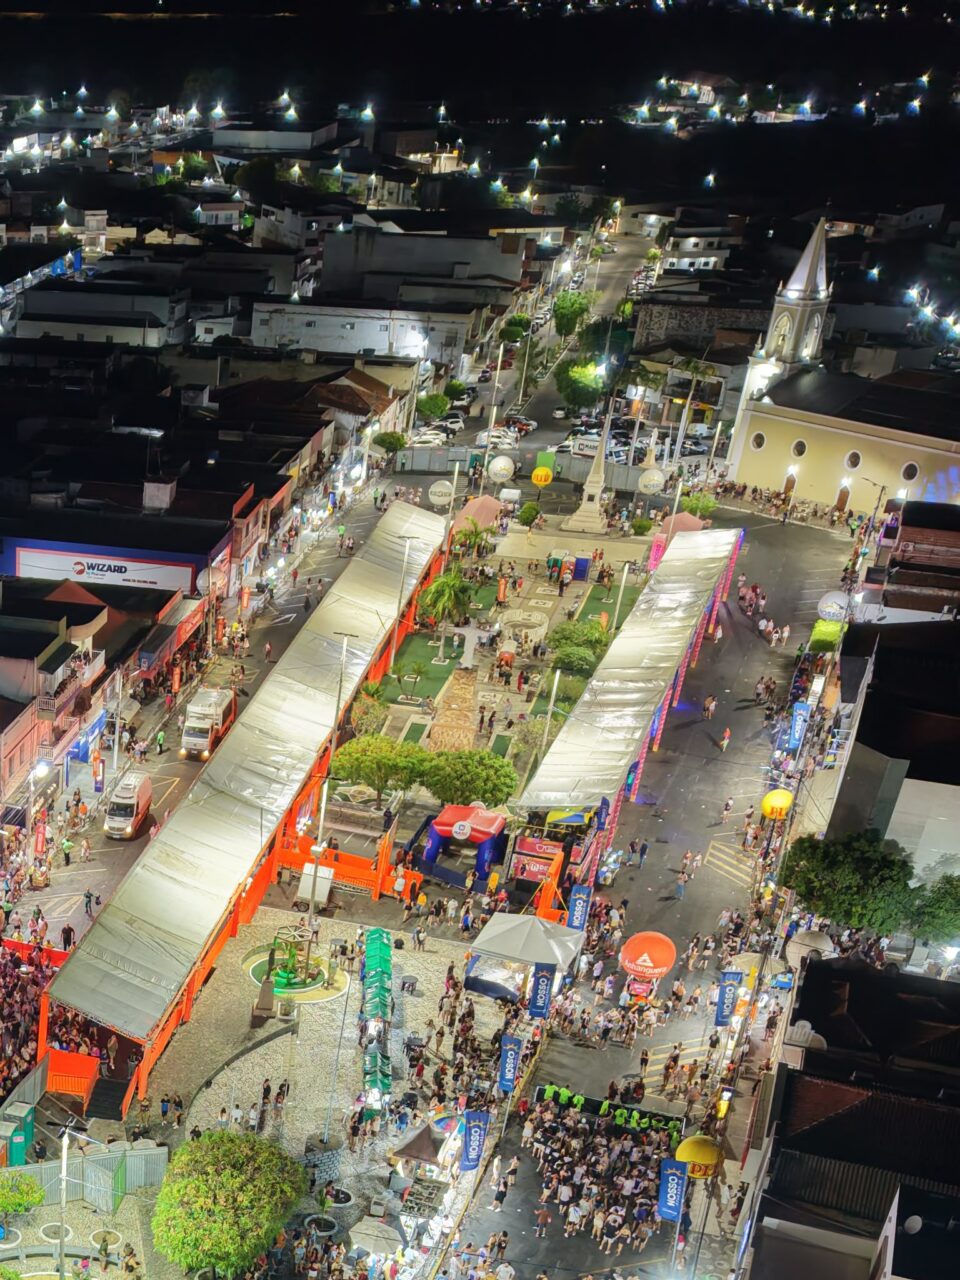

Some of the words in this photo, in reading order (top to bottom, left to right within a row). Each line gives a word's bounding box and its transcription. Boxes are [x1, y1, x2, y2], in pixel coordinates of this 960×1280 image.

[86, 562, 127, 574] WIZARD
[572, 900, 584, 927] NOSSO
[535, 977, 548, 1007] NOSSO
[723, 986, 735, 1016] NOSSO
[505, 1050, 515, 1080] NOSSO
[468, 1127, 481, 1159] NOSSO
[666, 1175, 678, 1207] NOSSO
